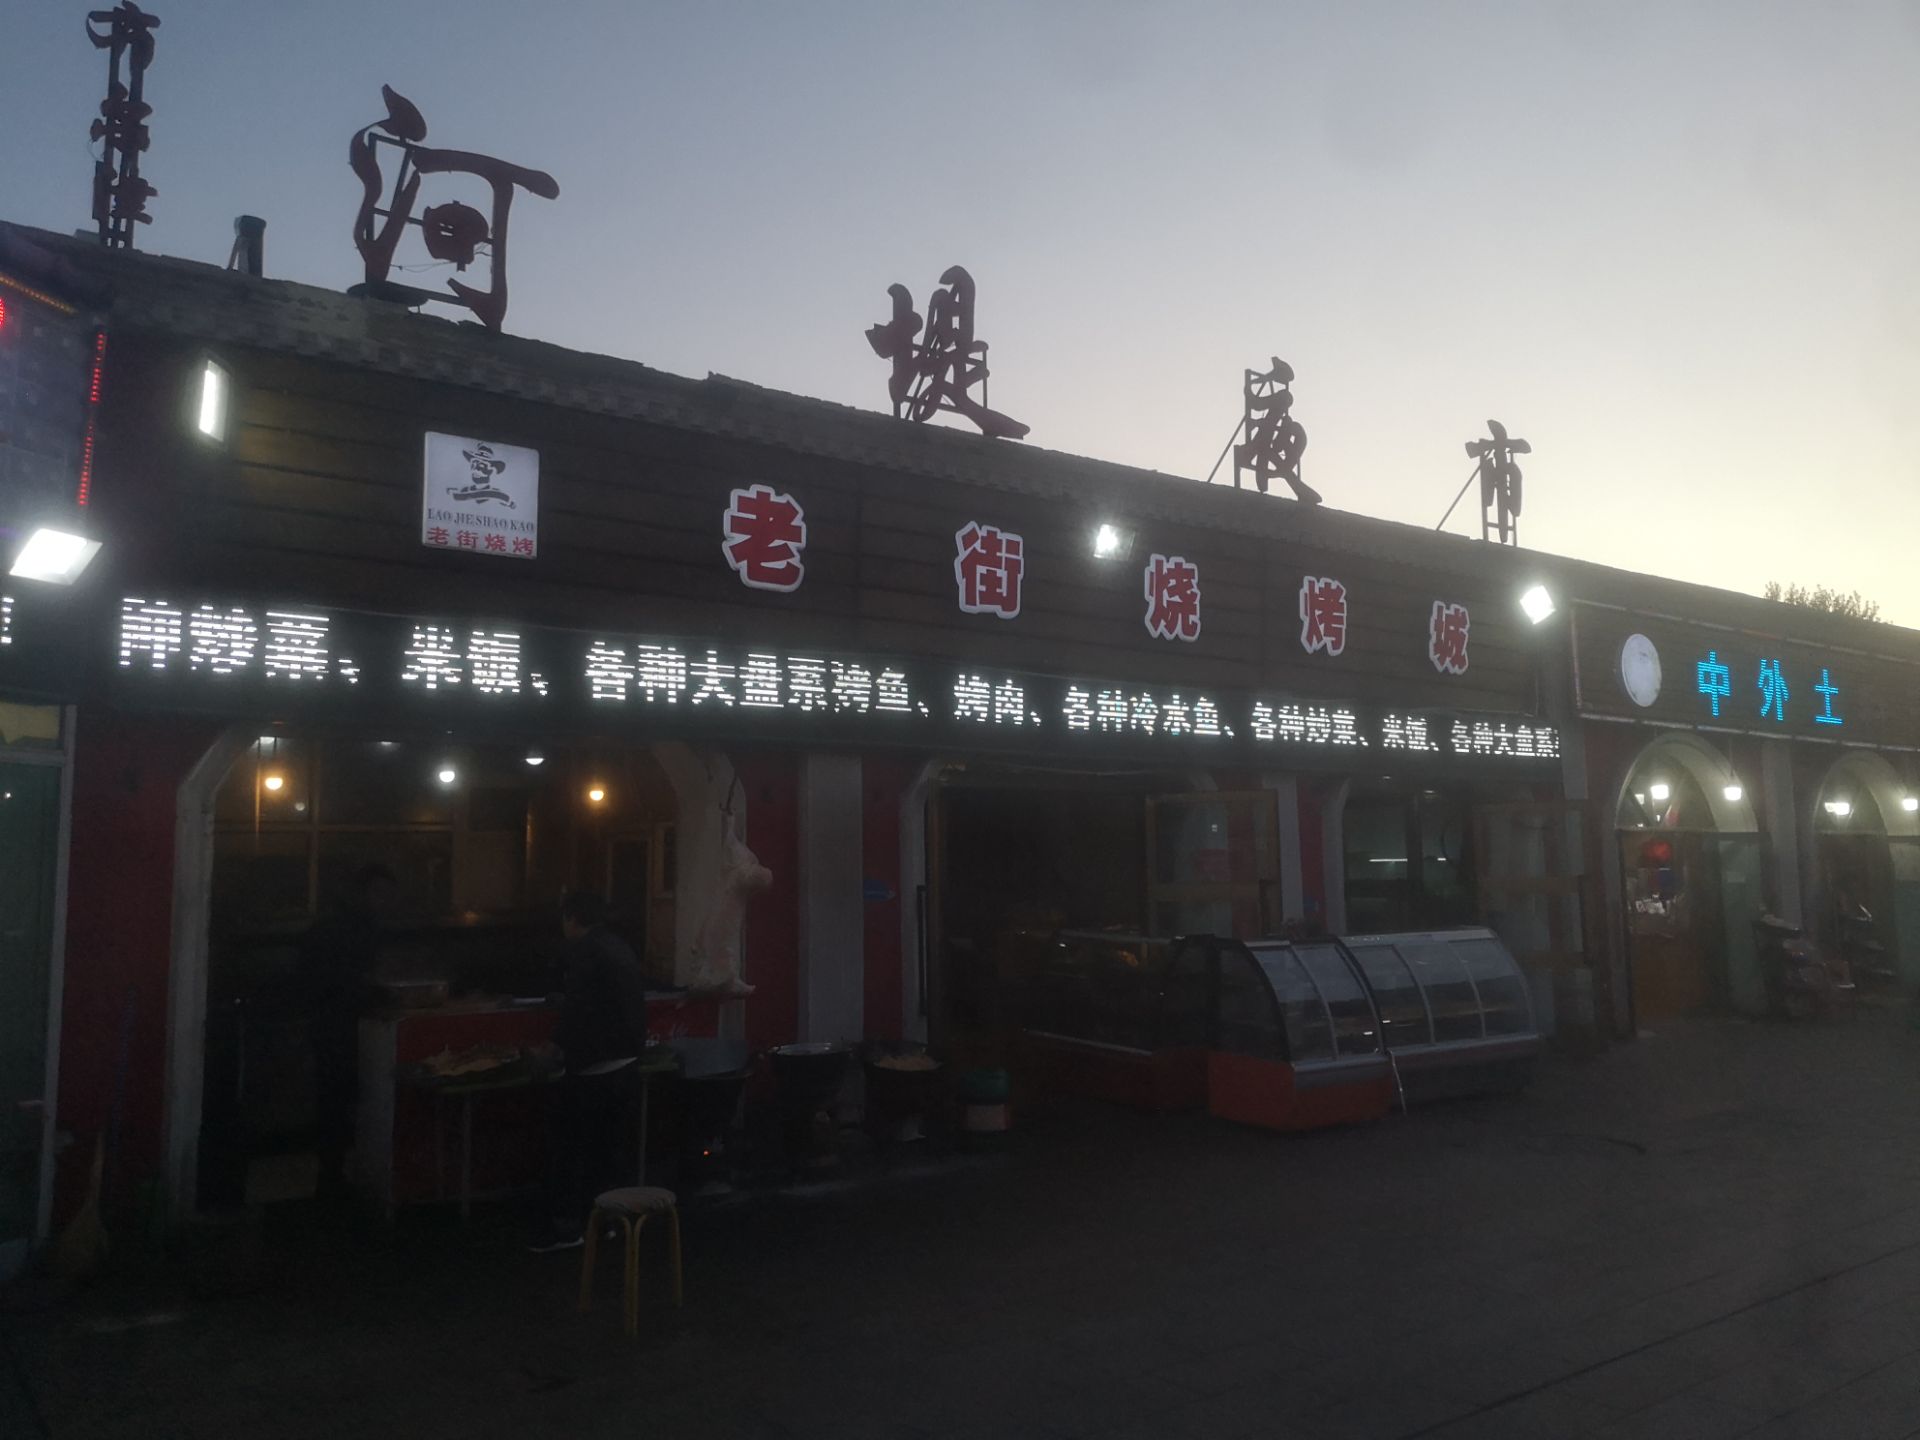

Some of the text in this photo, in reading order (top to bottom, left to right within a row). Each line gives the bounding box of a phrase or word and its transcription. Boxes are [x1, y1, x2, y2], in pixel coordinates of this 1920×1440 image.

[426, 526, 535, 556] 老街烧烤
[427, 508, 452, 521] LAO
[510, 519, 535, 532] KAO
[722, 484, 1470, 675] 老街烧烤城
[1697, 650, 1843, 726] 中外土
